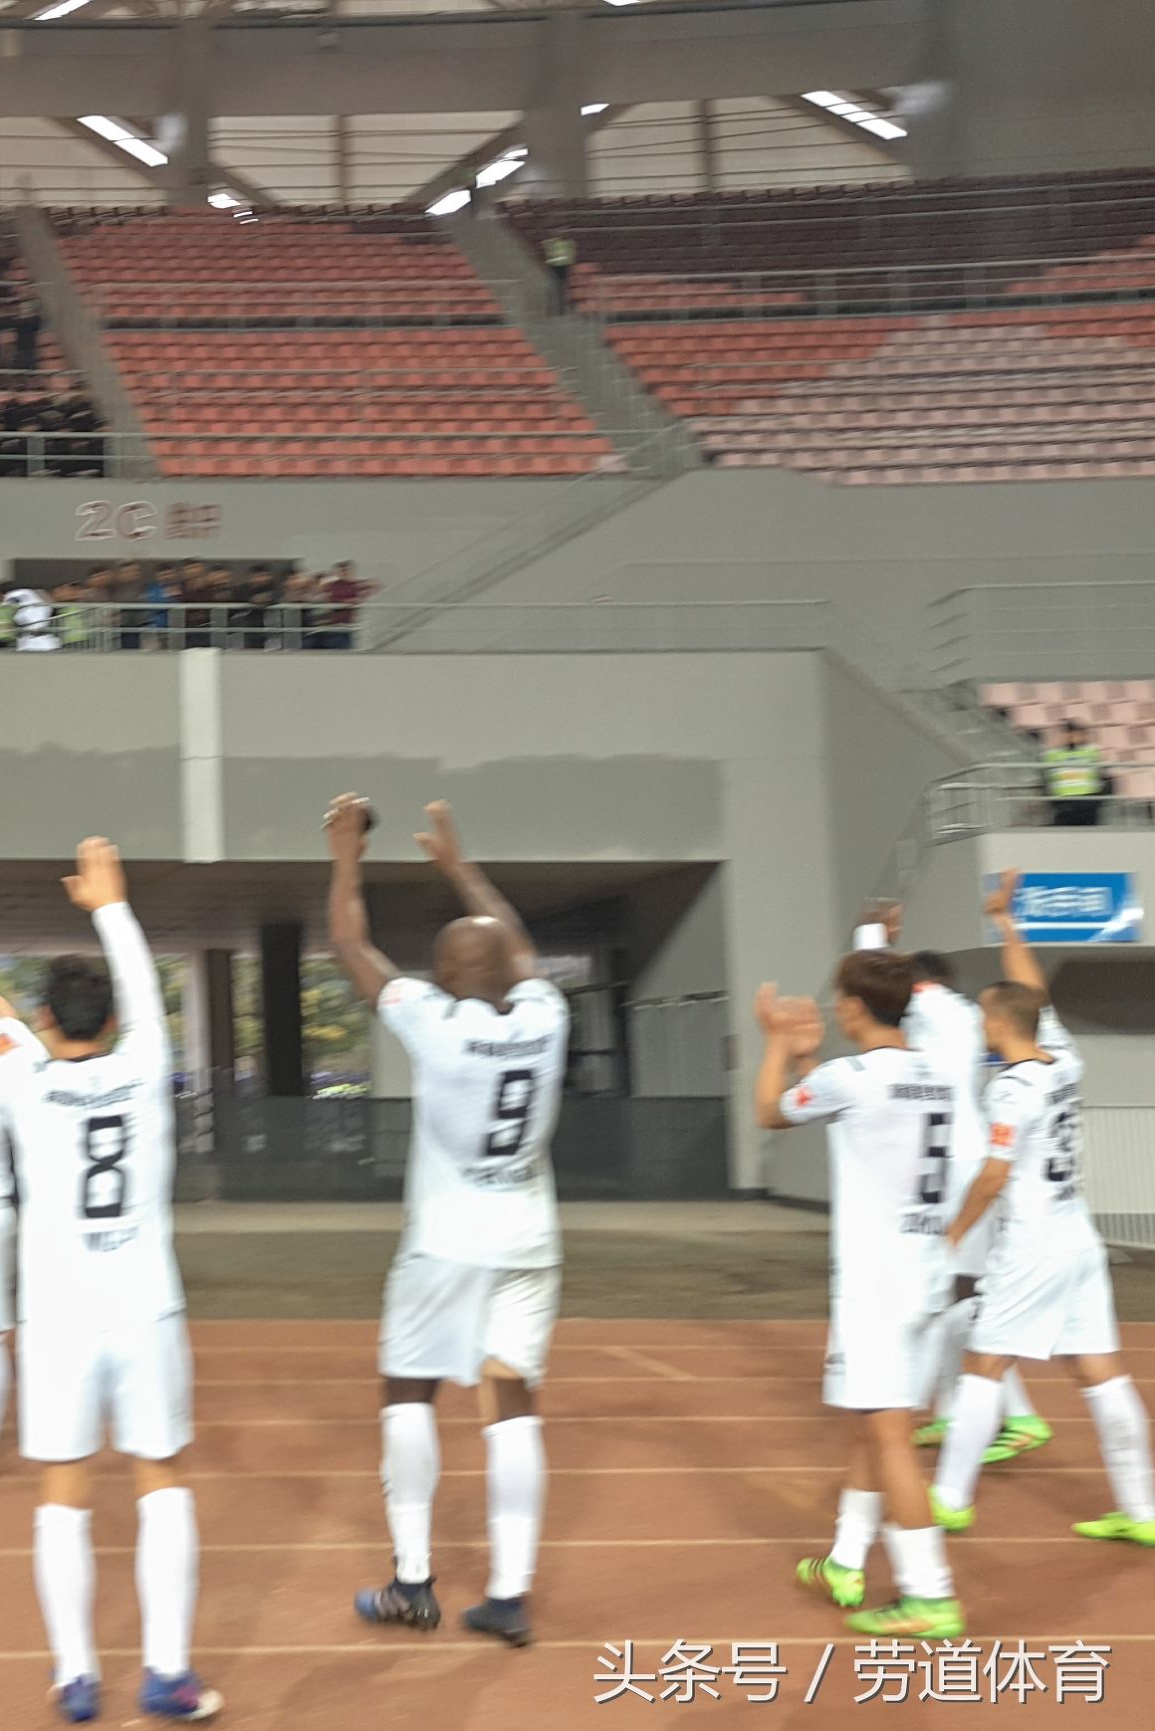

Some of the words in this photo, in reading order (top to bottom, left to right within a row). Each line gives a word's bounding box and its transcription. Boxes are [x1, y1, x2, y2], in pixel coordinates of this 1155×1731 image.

[75, 500, 157, 541] 2C
[482, 1068, 534, 1157] 9
[79, 1113, 131, 1219] 8
